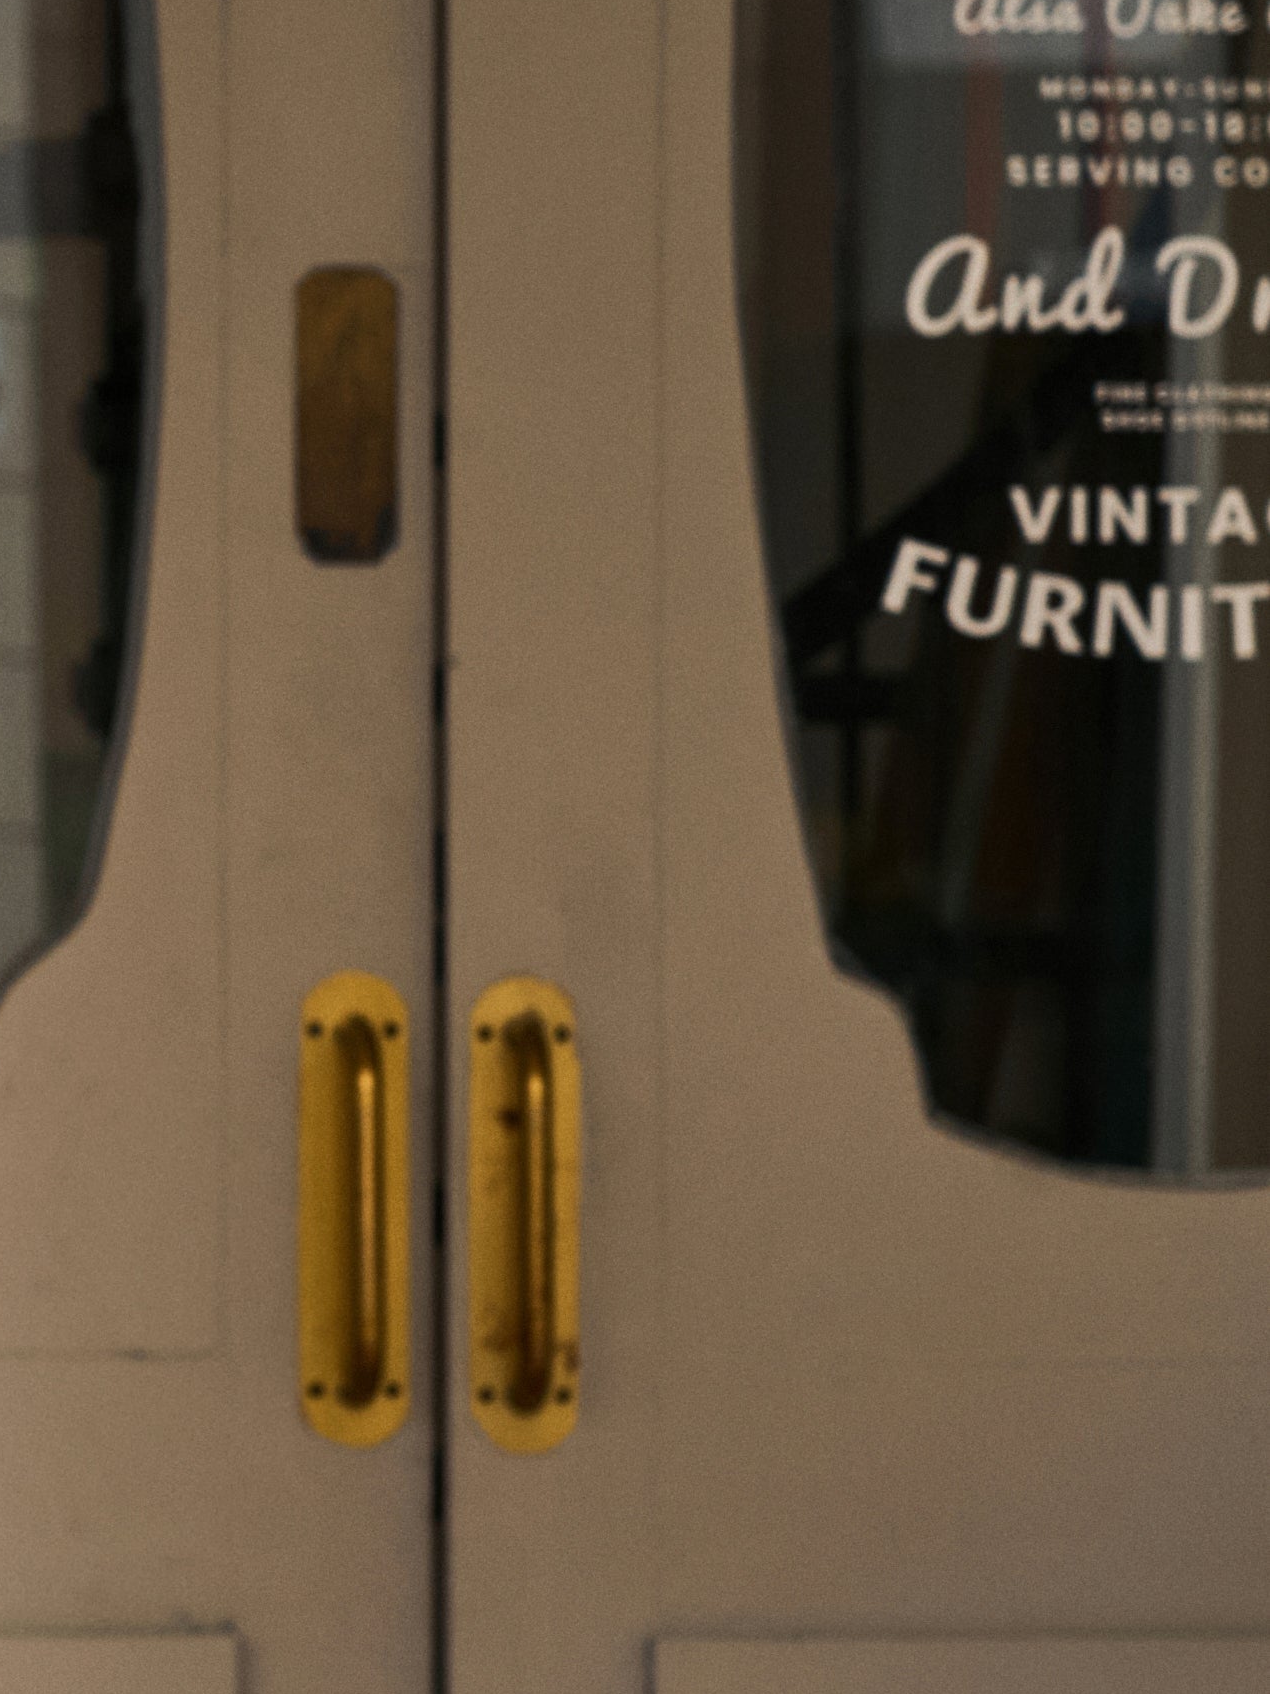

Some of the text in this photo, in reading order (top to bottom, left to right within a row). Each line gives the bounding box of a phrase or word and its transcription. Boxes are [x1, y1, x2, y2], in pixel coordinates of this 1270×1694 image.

[1039, 77, 1270, 102] MONDAY-SUN
[1006, 155, 1270, 189] SERVING CO
[905, 224, 1126, 338] And
[1008, 485, 1270, 545] VINTA
[880, 537, 1270, 662] FURNIT
